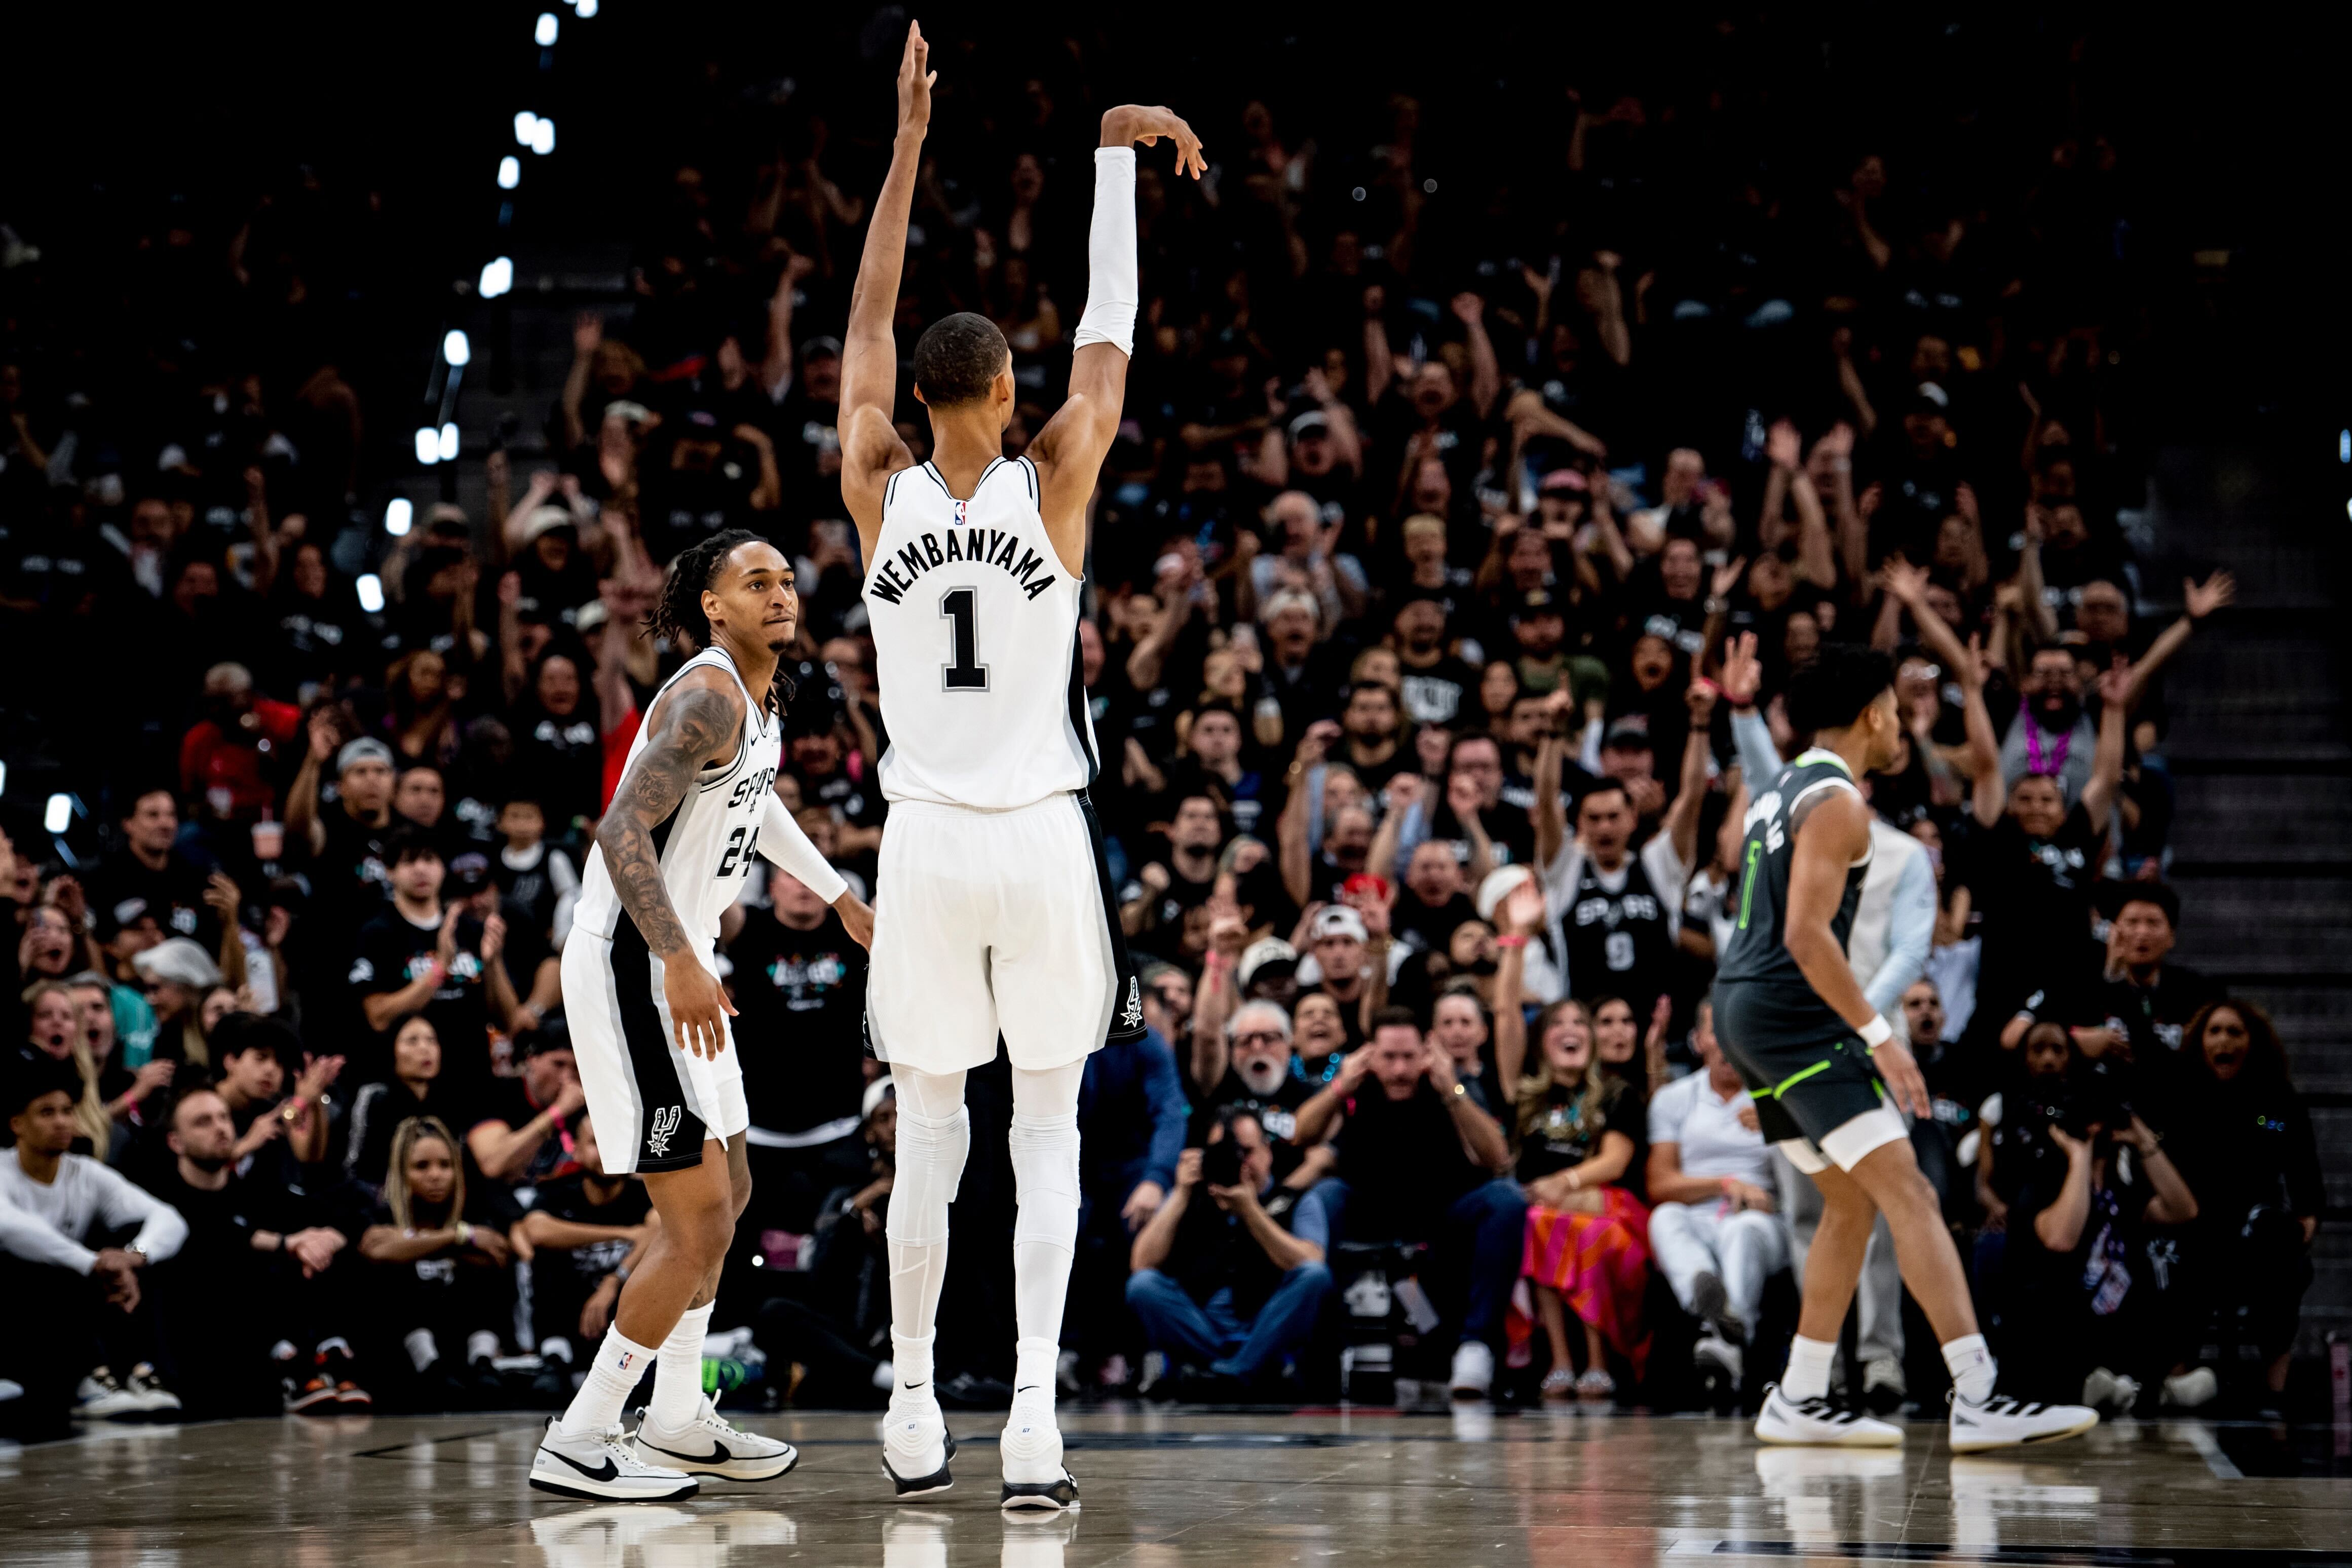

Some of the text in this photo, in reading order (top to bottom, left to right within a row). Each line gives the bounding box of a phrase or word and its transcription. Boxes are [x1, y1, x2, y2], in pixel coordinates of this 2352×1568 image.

[870, 528, 1056, 605] WEMBANYAMA
[938, 586, 991, 693] 1
[713, 824, 762, 880] 24
